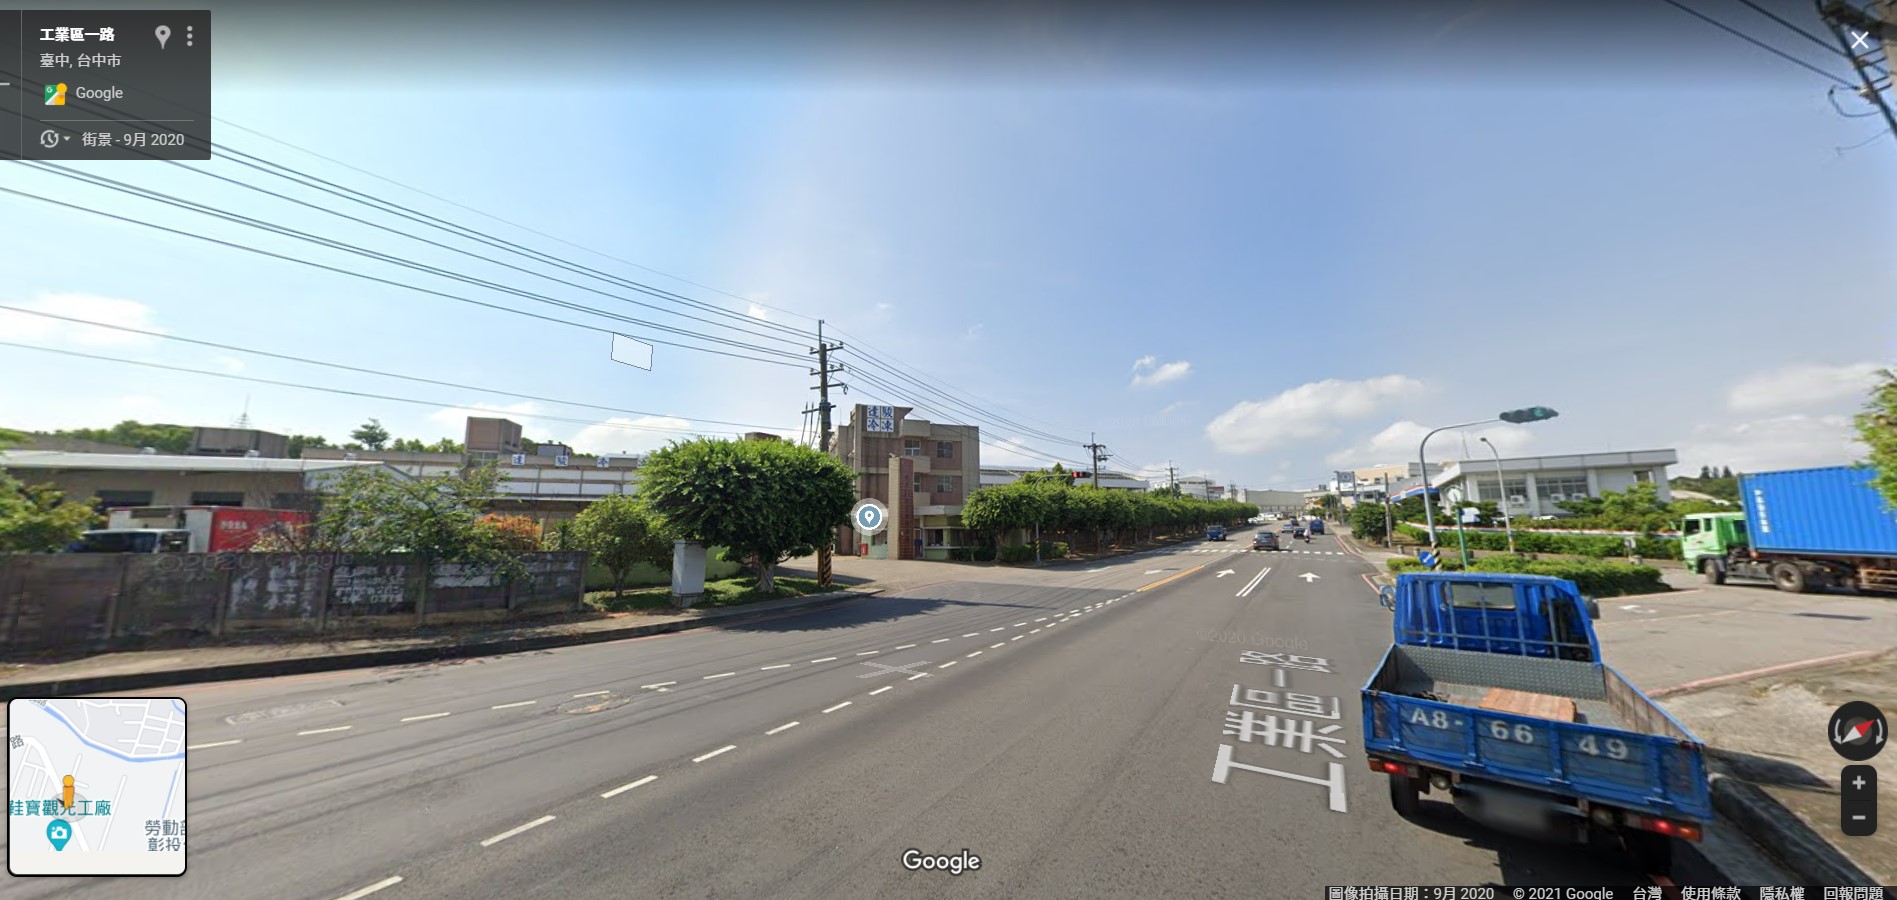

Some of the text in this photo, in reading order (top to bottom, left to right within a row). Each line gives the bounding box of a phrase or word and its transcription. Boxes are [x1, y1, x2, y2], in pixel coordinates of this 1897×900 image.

[868, 419, 893, 431] 冷凍
[1211, 649, 1347, 813] 工業區一路
[1490, 720, 1534, 744] 66
[1577, 734, 1629, 760] 49
